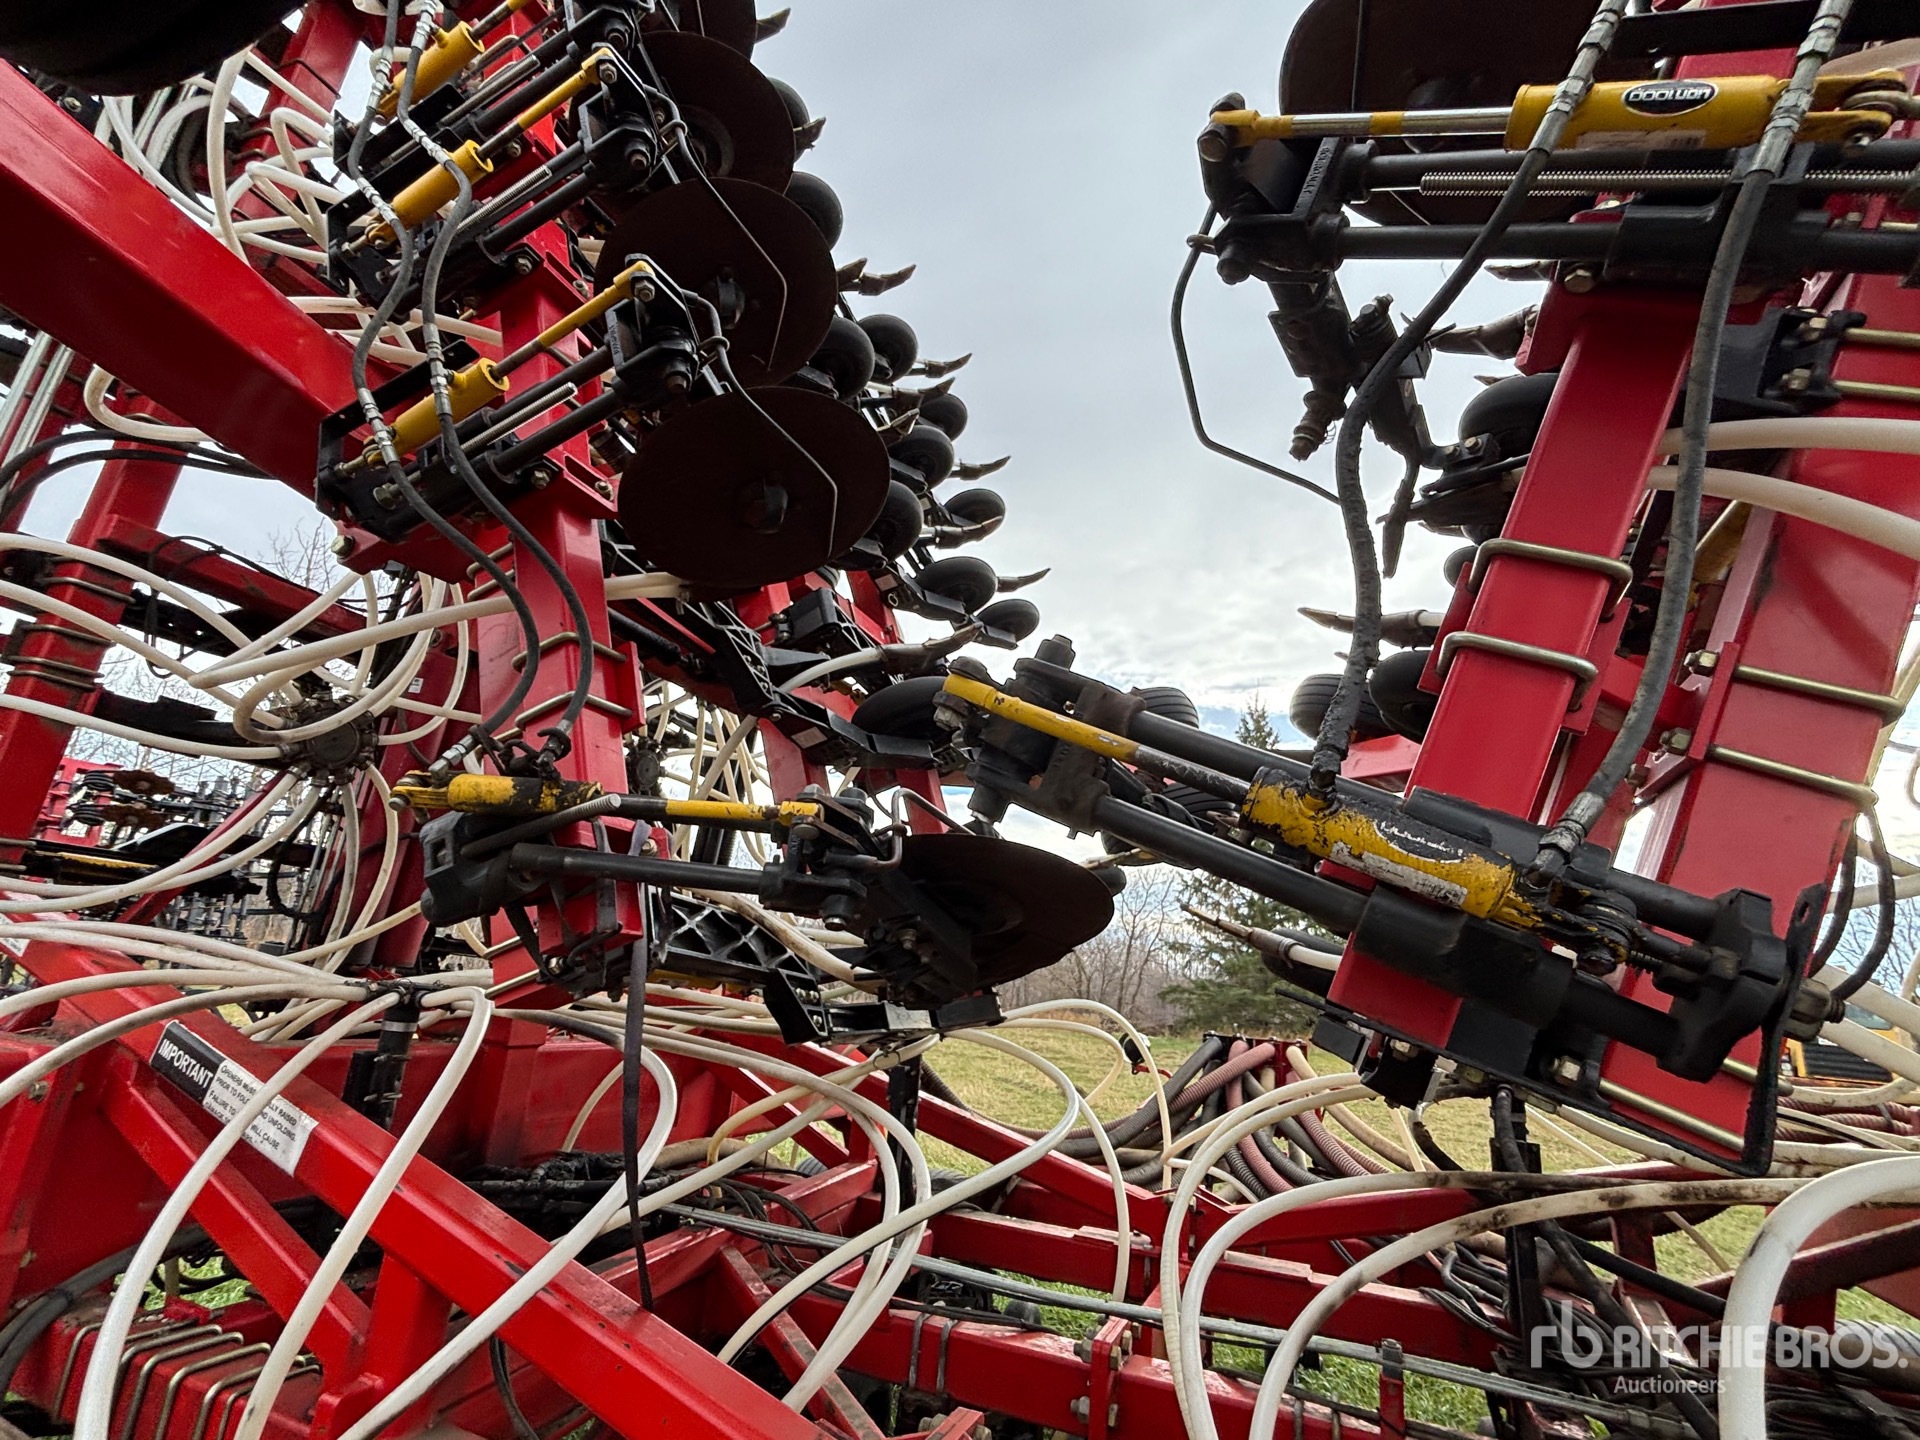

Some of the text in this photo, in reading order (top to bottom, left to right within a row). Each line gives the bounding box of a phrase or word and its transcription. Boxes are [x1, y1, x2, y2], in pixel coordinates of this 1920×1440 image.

[158, 1039, 214, 1088] IMPORTANT
[216, 1077, 231, 1091] PRIOR
[230, 1086, 238, 1096] TO
[208, 1090, 229, 1111] FAILURE
[228, 1106, 237, 1116] TO
[250, 1124, 262, 1137] WILL
[262, 1132, 280, 1150] CAUSE
[221, 1065, 243, 1086] OPENERS
[278, 1109, 298, 1126] RAISED
